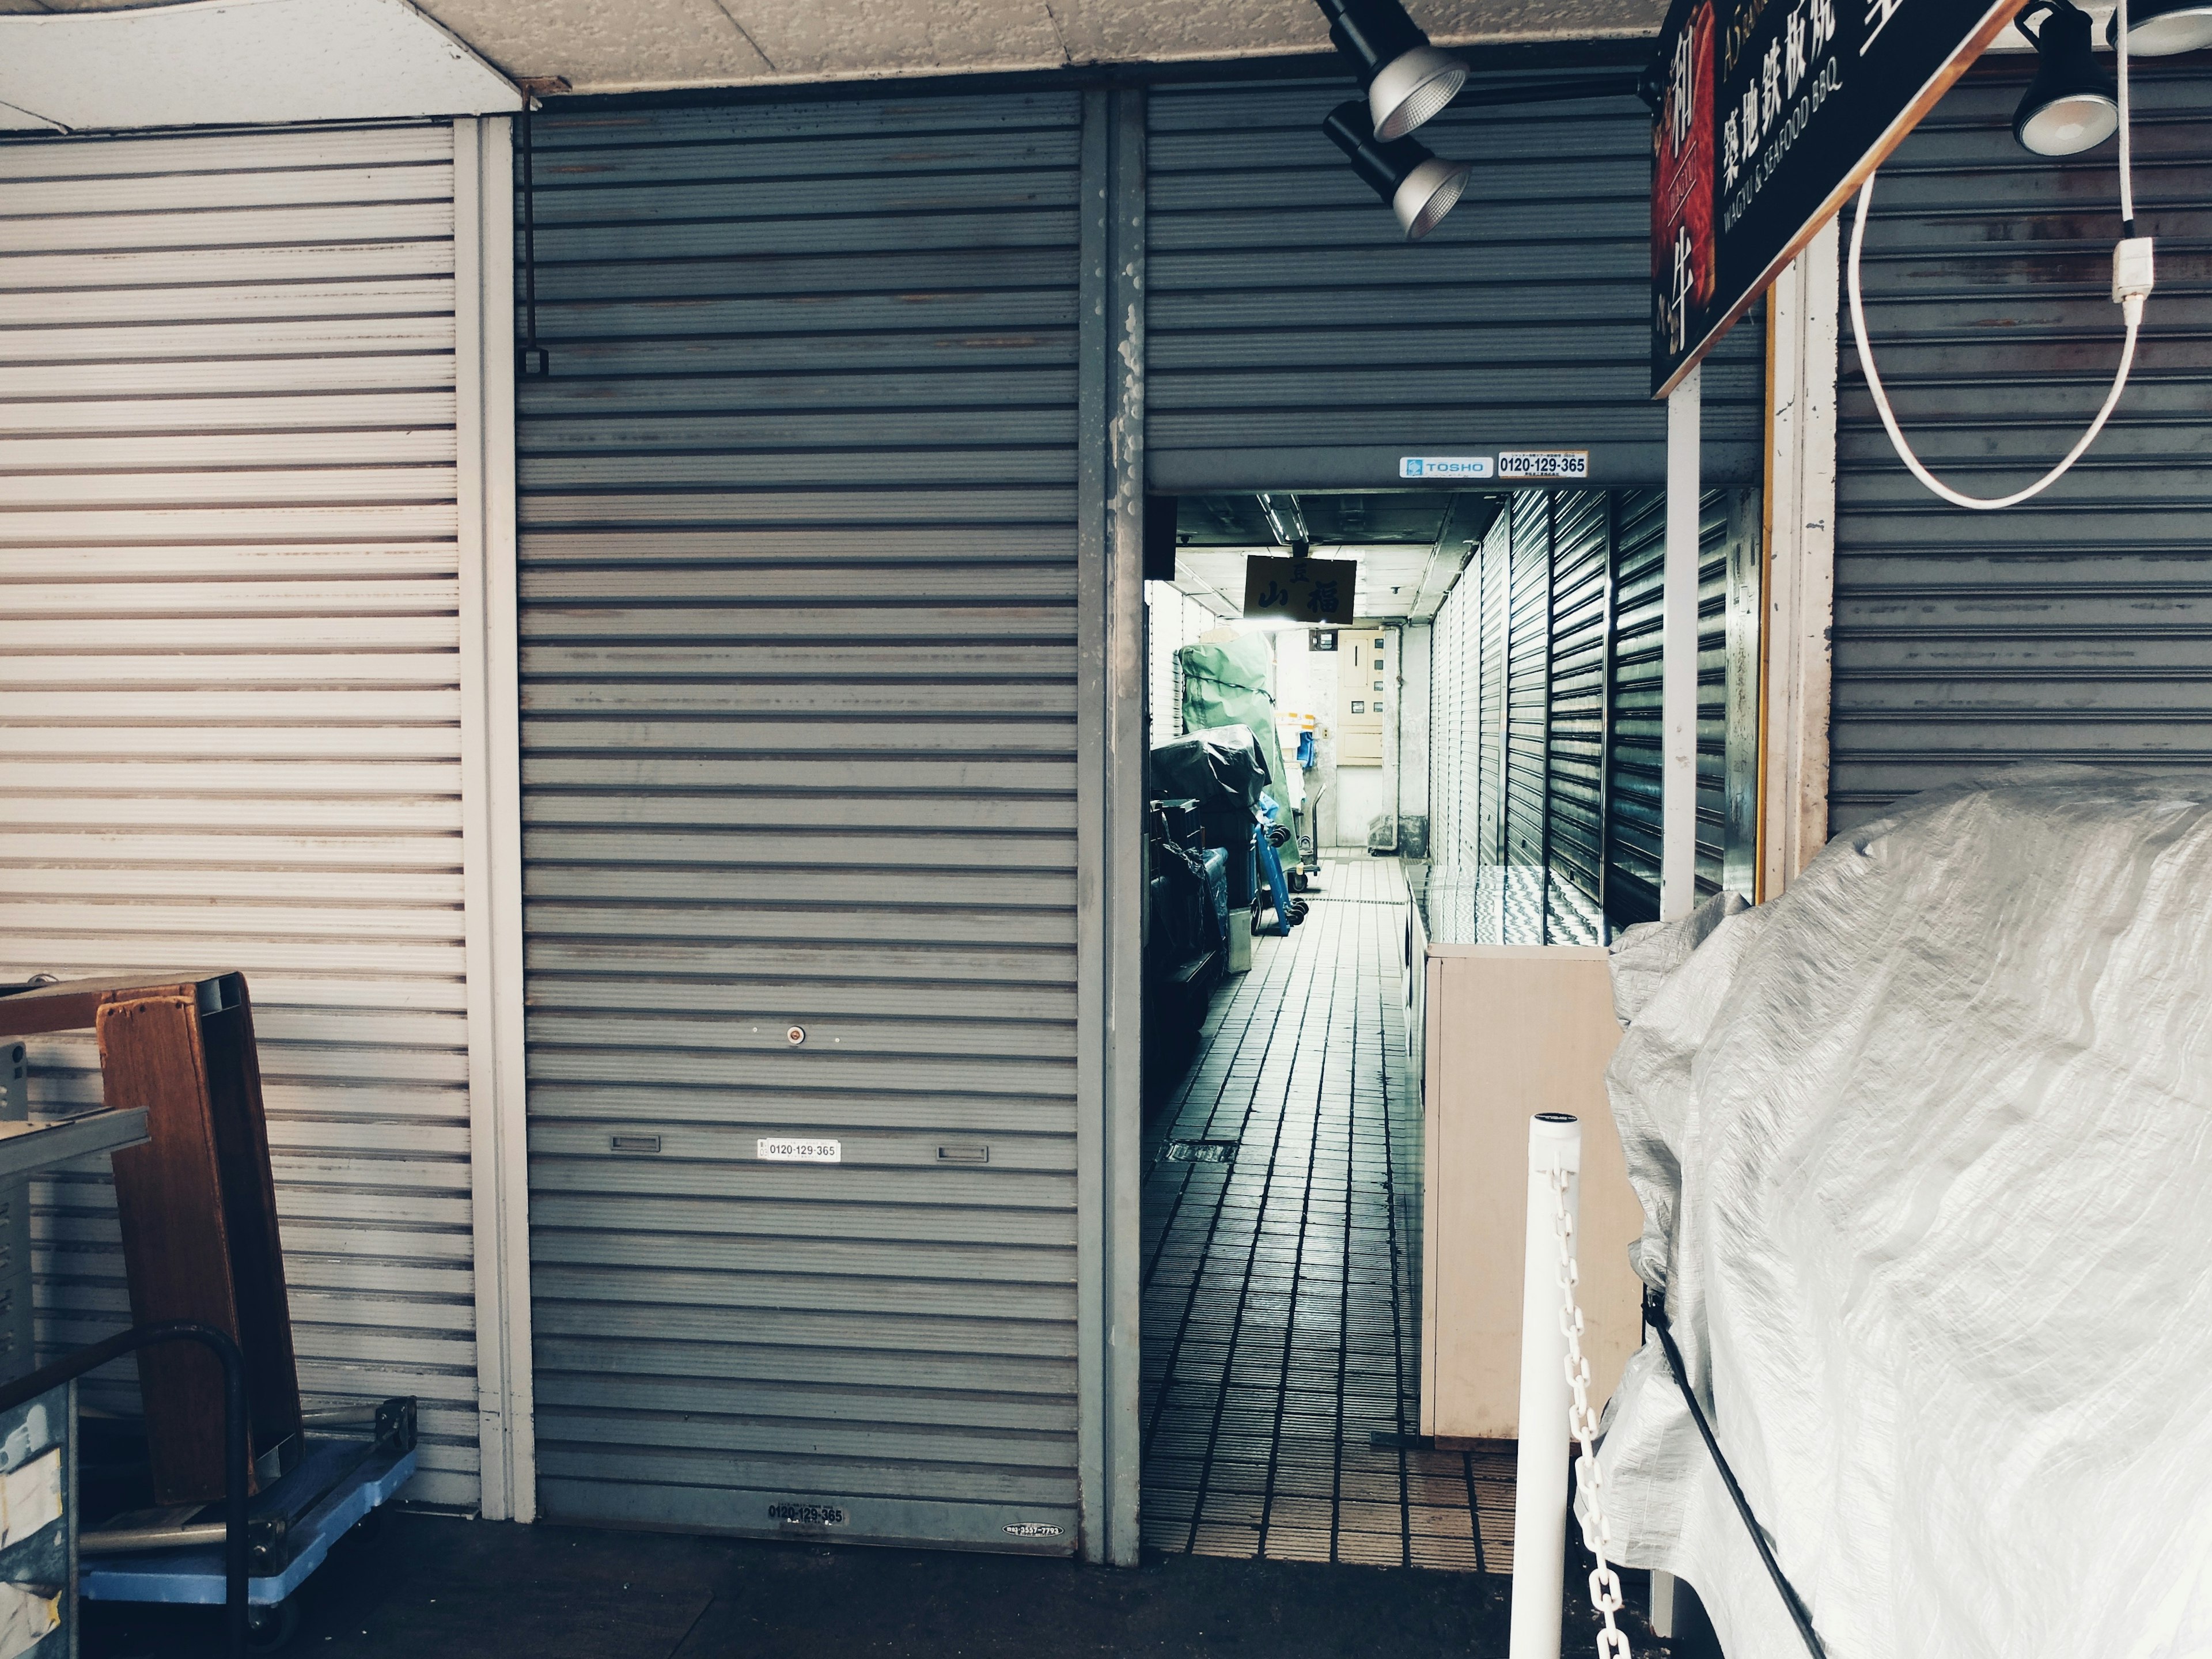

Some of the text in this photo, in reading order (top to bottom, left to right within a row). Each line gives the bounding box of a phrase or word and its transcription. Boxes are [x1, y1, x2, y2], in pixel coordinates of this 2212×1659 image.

[1724, 56, 1843, 234] WAGYU & SEAFOOD BBQ
[1426, 463, 1483, 472] TOSHO
[1500, 457, 1585, 472] 0120-129-365
[770, 1145, 835, 1156] 0120-129-365
[768, 1505, 843, 1522] 0120-129-365
